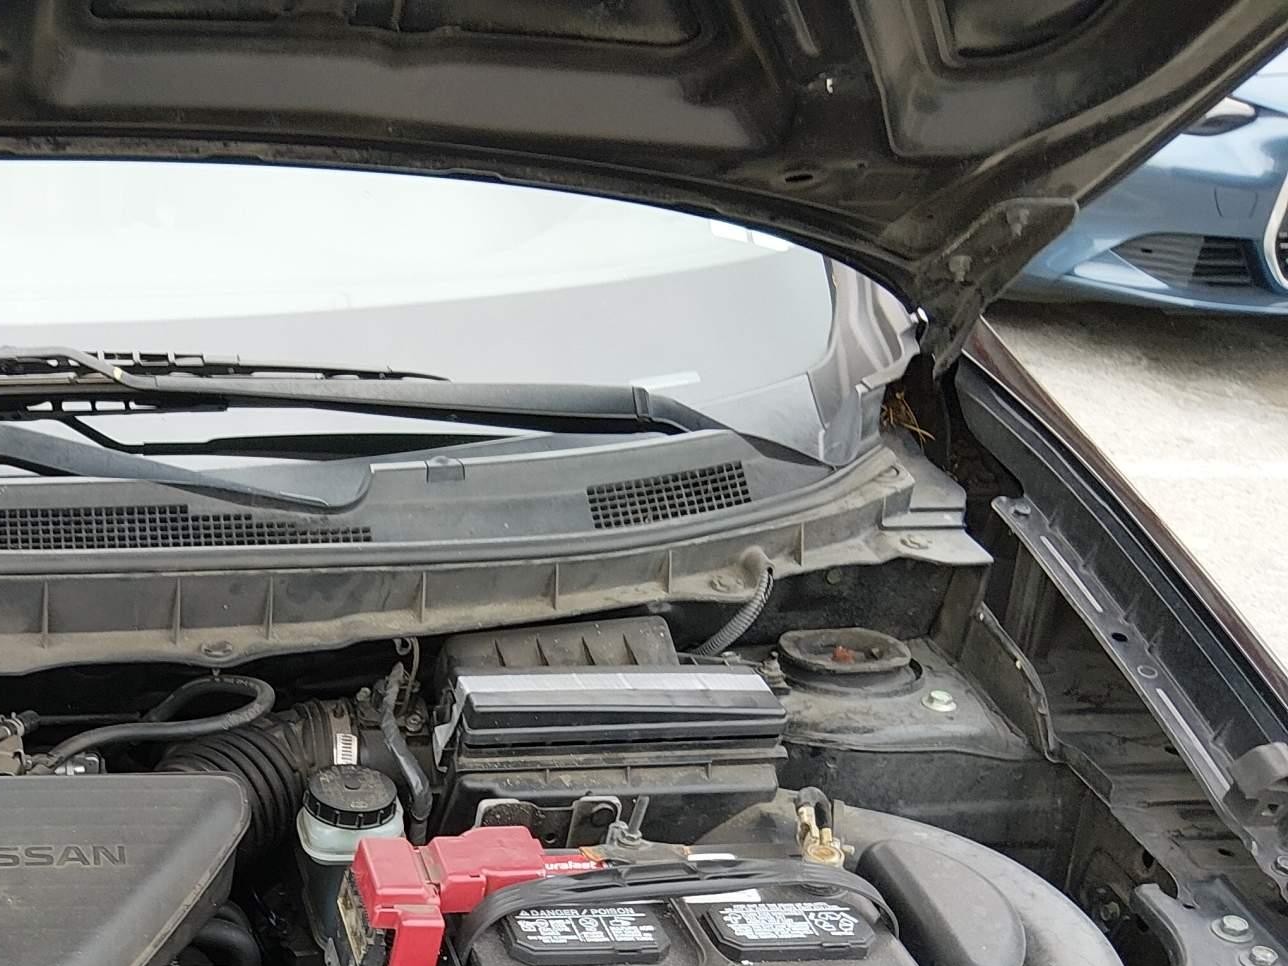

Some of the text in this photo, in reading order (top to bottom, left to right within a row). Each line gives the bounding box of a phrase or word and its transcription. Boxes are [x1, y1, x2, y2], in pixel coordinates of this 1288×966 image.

[545, 862, 597, 871] uralast
[531, 909, 579, 917] DANGER
[591, 907, 635, 916] POISON
